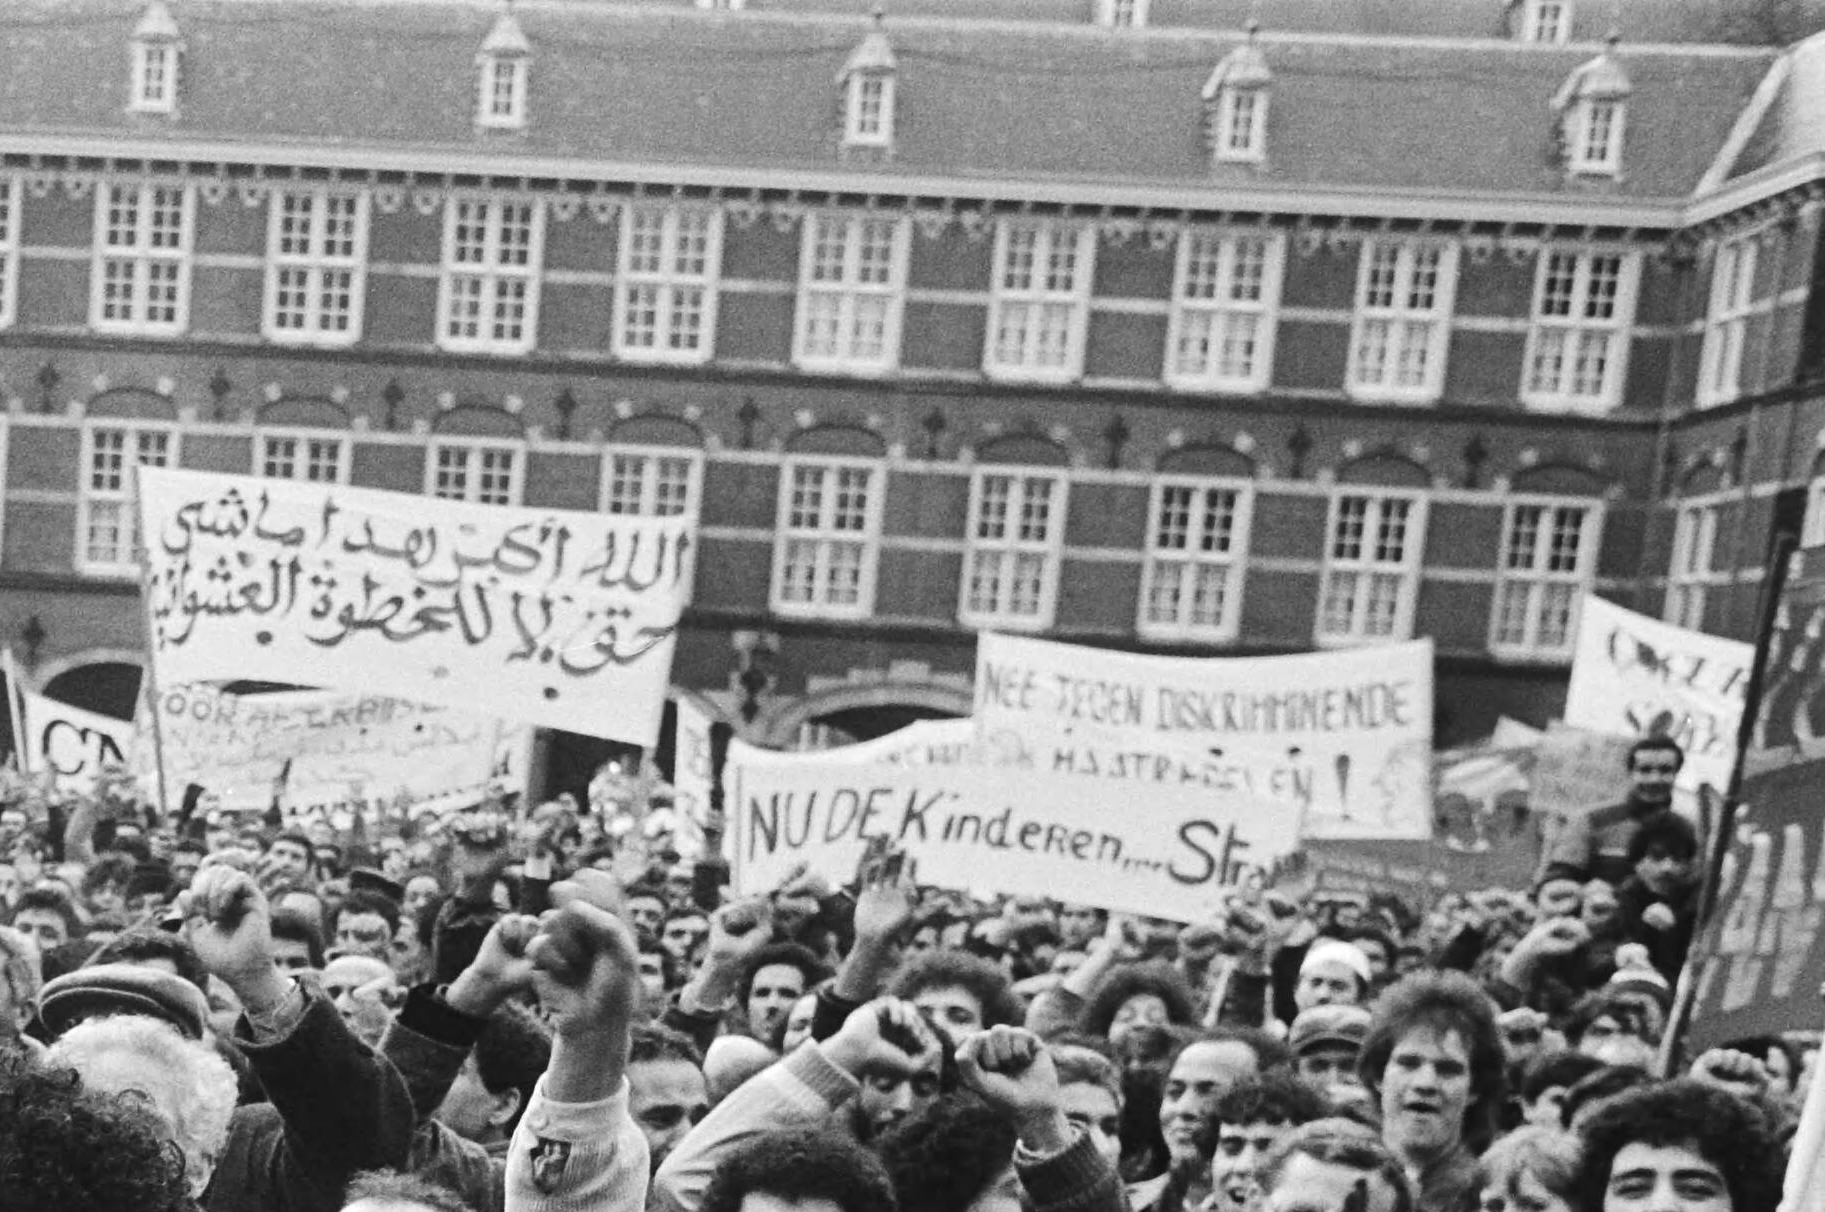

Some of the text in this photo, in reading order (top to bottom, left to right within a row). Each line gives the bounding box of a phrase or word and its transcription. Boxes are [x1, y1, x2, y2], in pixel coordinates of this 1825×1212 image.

[1052, 672, 1143, 728] TEGEN
[747, 791, 818, 862] NU
[824, 787, 893, 844] DE
